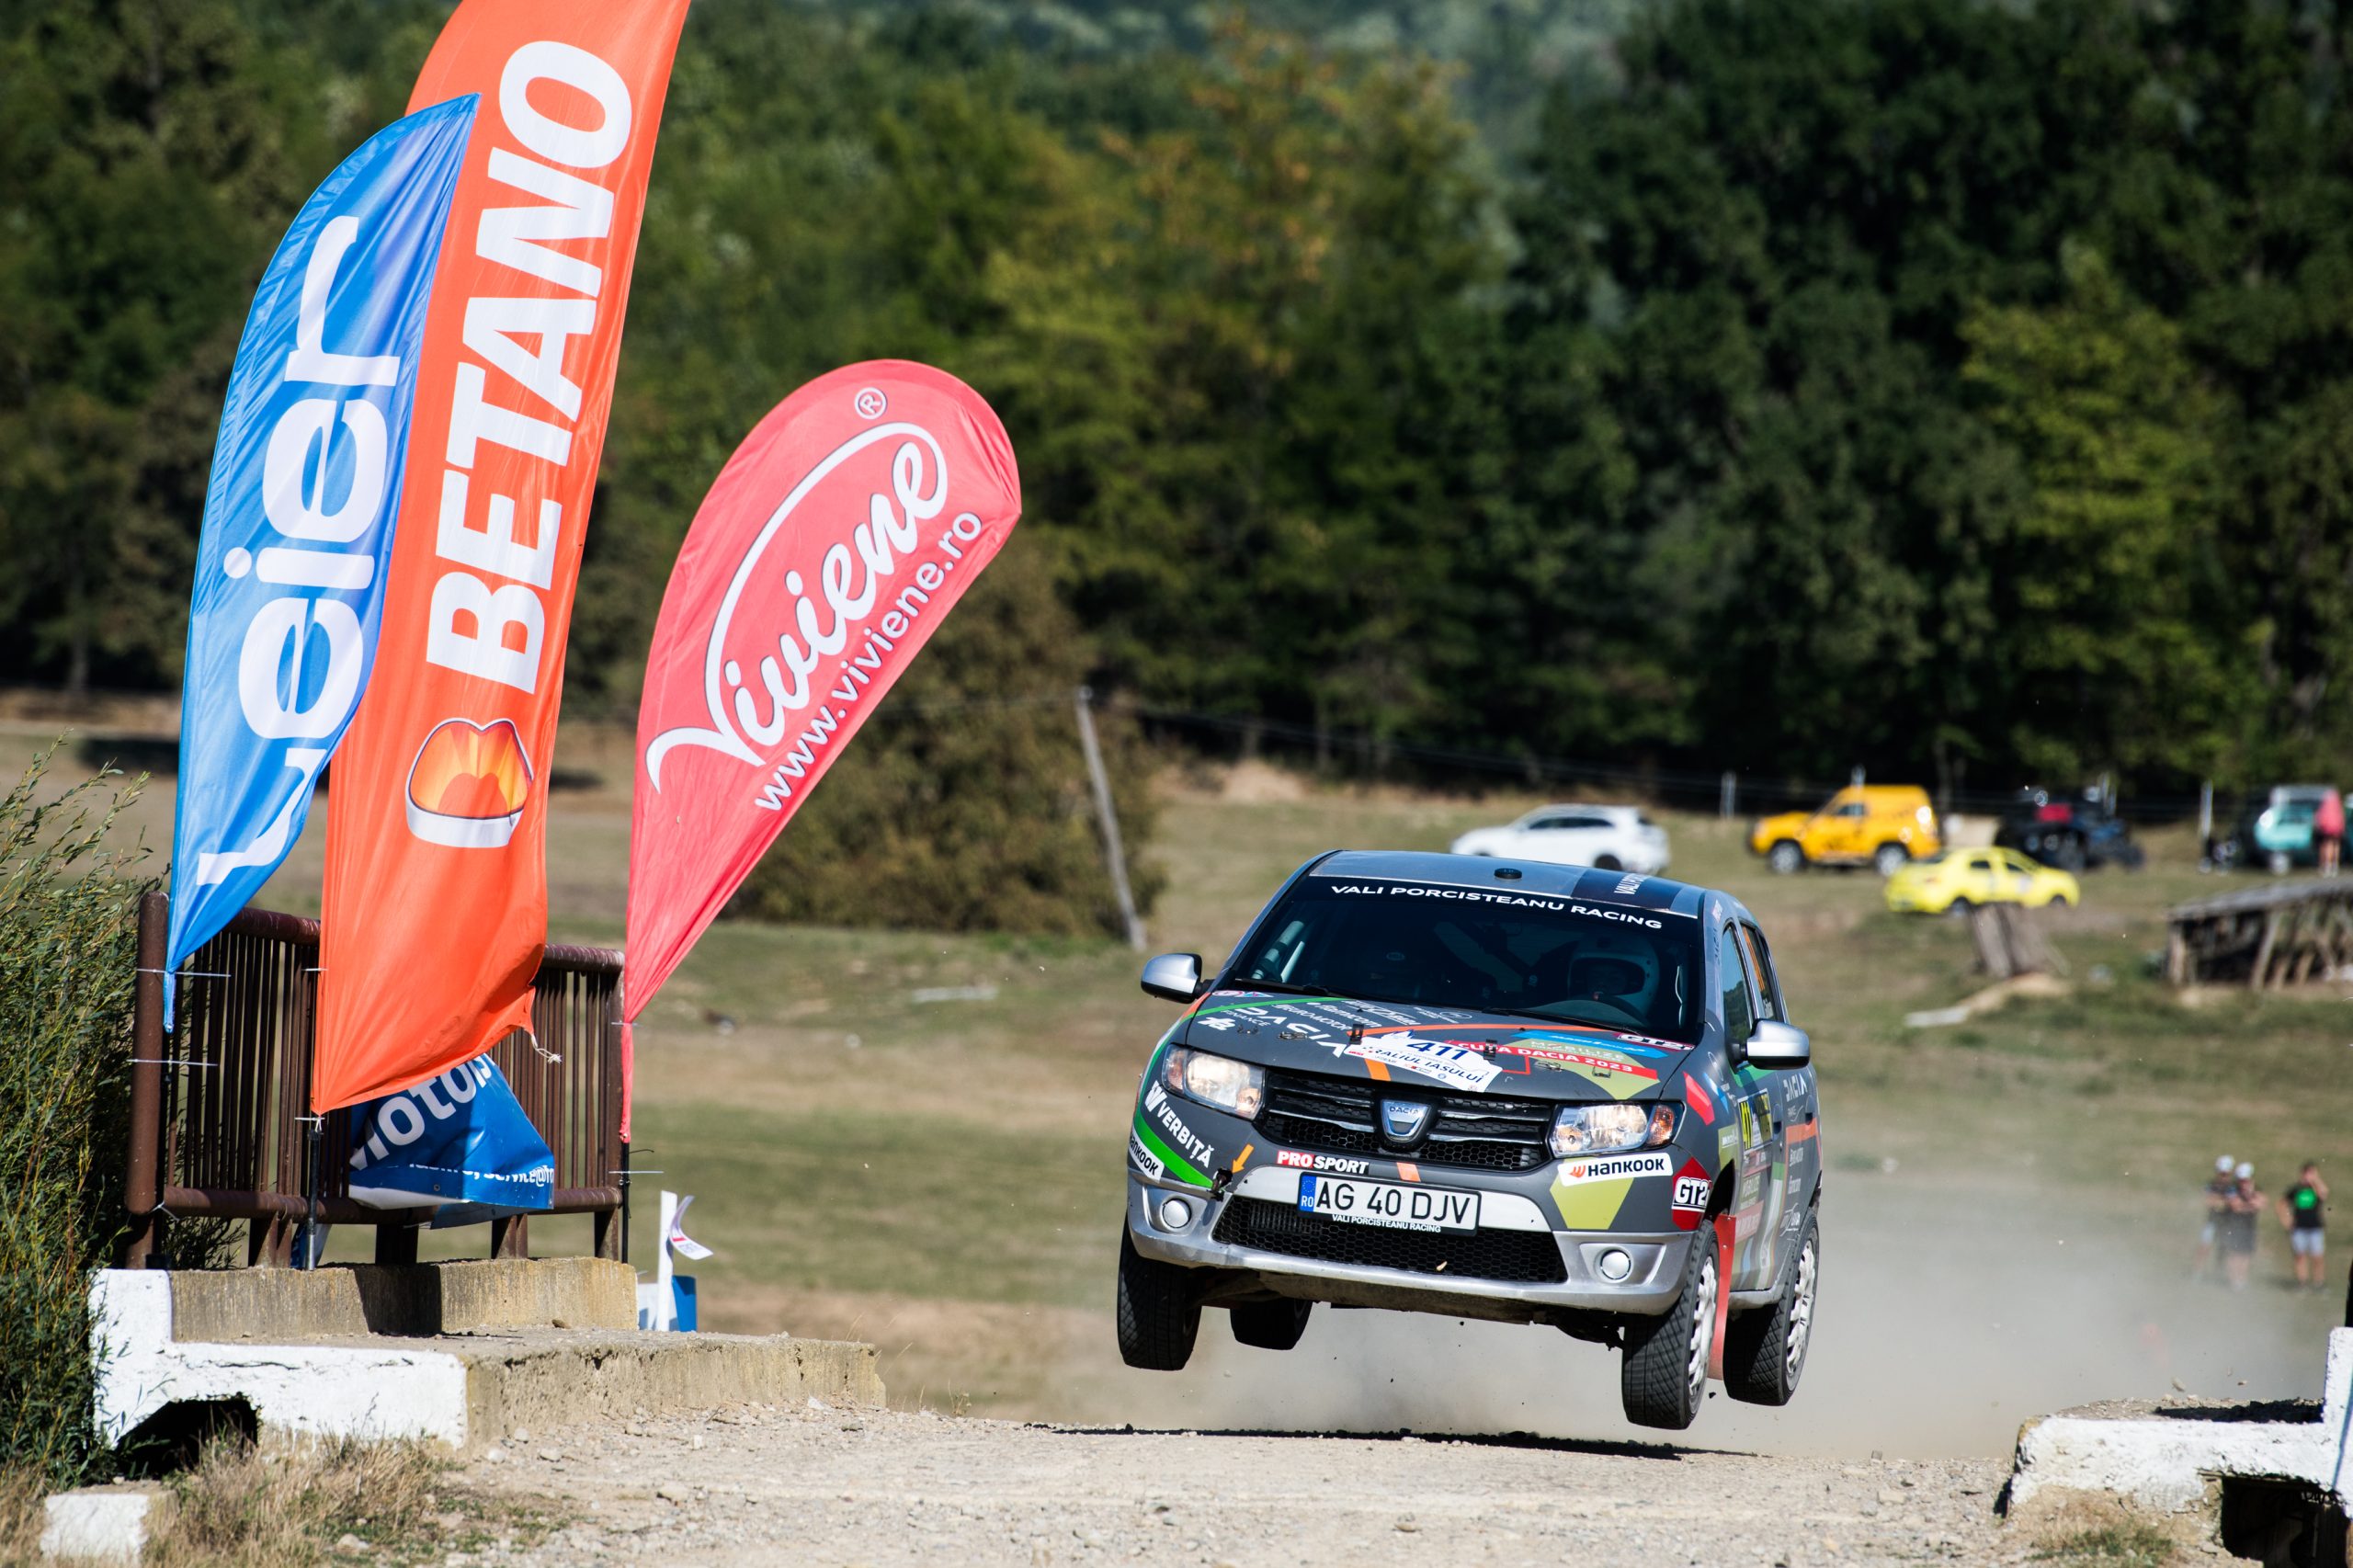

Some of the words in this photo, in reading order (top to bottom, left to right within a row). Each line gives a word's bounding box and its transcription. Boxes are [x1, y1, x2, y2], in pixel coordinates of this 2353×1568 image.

[426, 40, 632, 694] BETANO
[755, 511, 982, 811] www.viviene.ro
[1331, 886, 1384, 894] VALI
[1391, 887, 1564, 911] PORCISTEANU
[1571, 905, 1663, 929] RACING
[1234, 1006, 1347, 1058] DACIA
[1375, 1049, 1421, 1065] RALIUL
[1406, 1040, 1470, 1061] 411
[1518, 1049, 1578, 1062] DACIA
[1586, 1058, 1632, 1073] 2023
[1389, 1106, 1419, 1115] DACIA
[1158, 1101, 1214, 1168] VERBIȚĂ
[1277, 1151, 1313, 1168] PRO
[1313, 1155, 1370, 1175] SPORT
[1301, 1195, 1314, 1208] RO
[1316, 1181, 1355, 1210] AG
[1367, 1187, 1402, 1216] 40
[1411, 1191, 1471, 1224] DJV
[1332, 1214, 1352, 1223] VALI
[1354, 1216, 1408, 1231] PORCISTEANU
[1409, 1223, 1441, 1233] RACING
